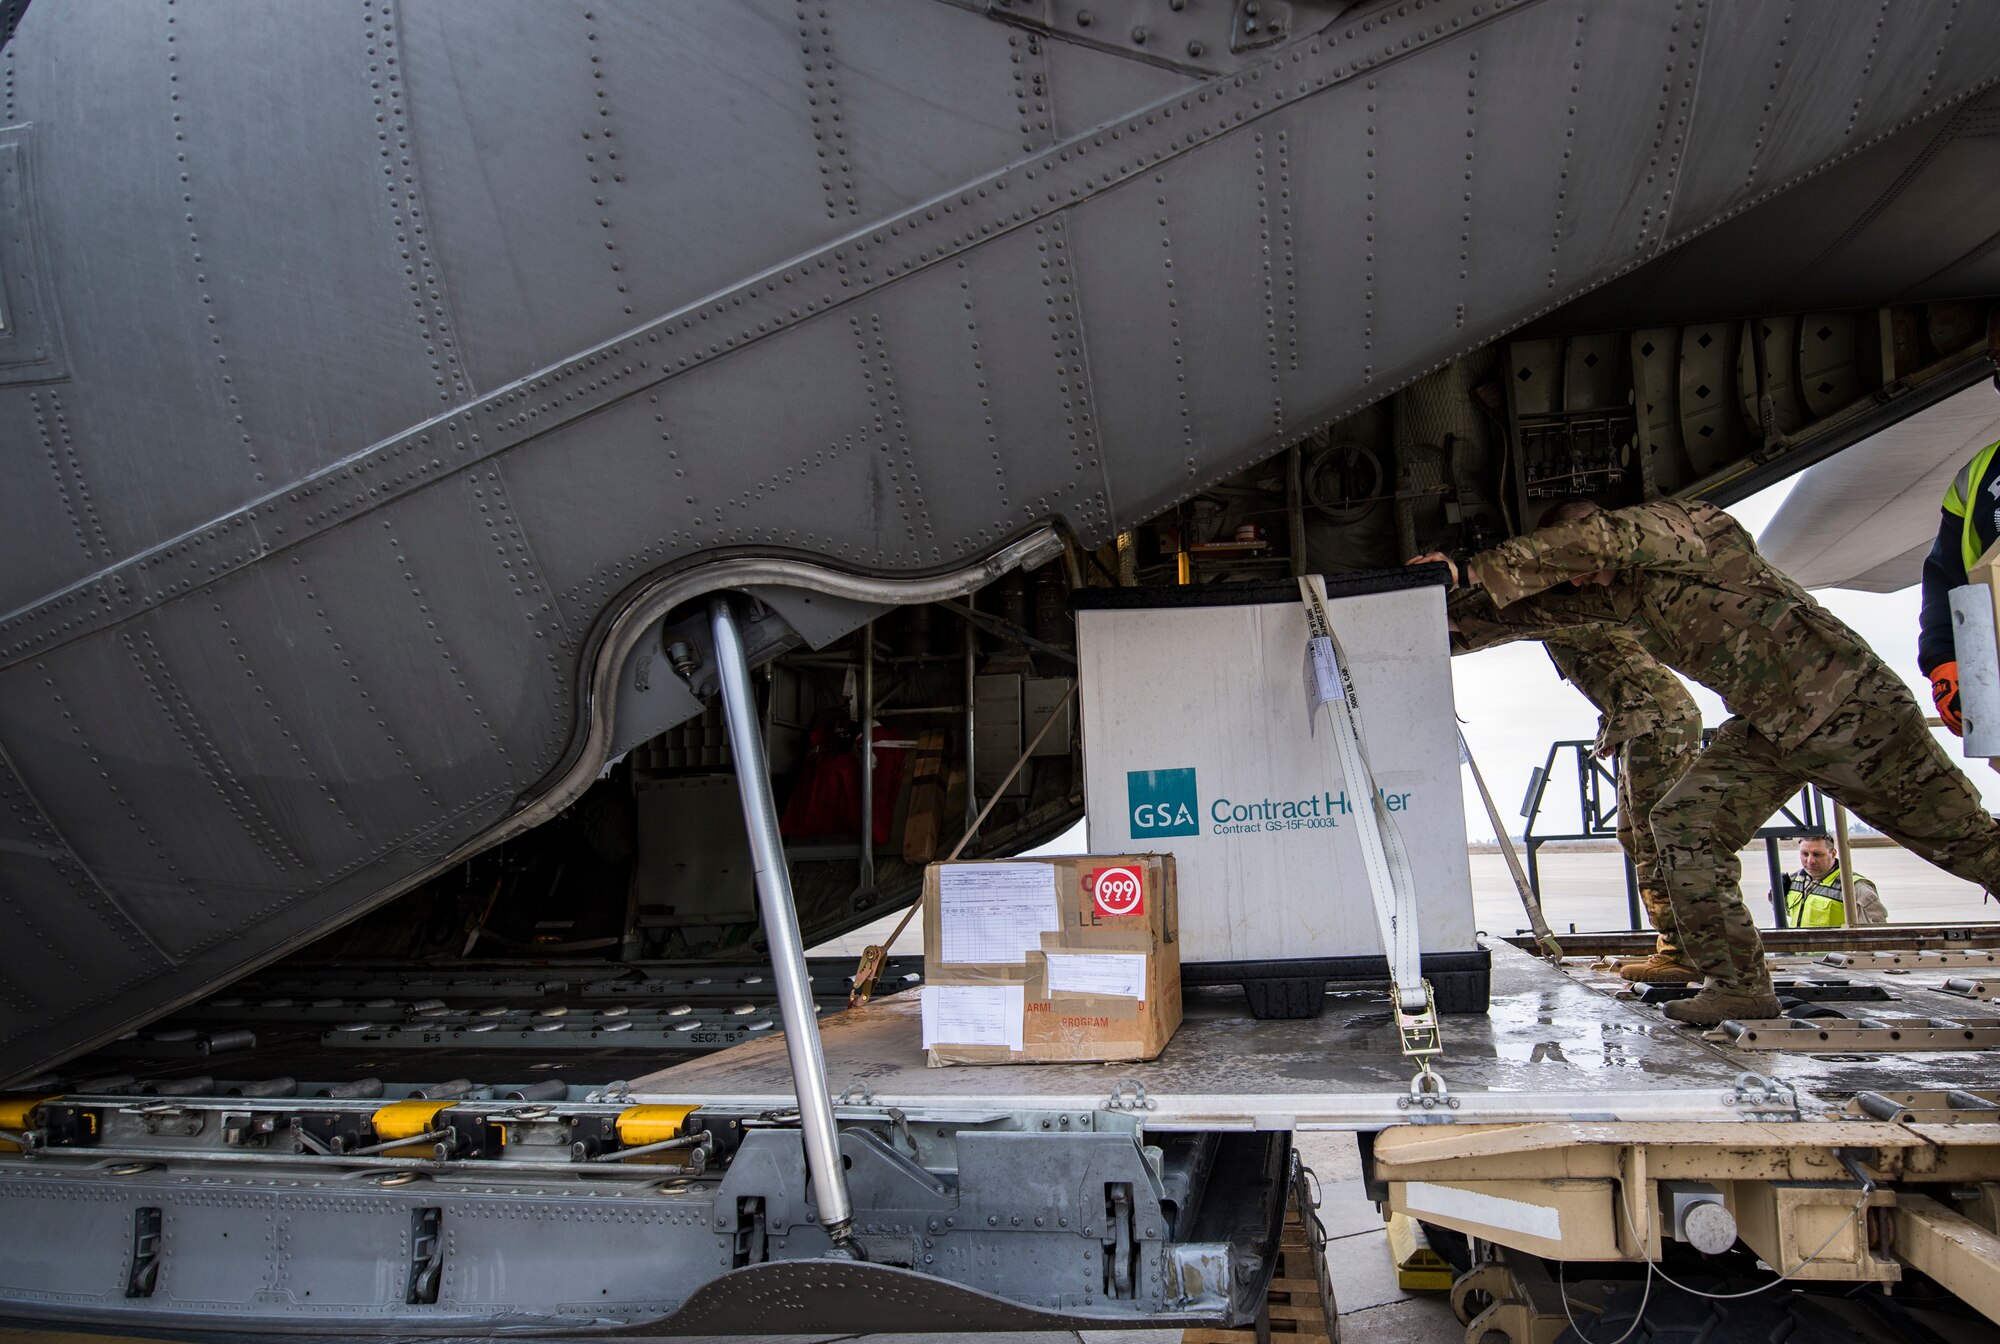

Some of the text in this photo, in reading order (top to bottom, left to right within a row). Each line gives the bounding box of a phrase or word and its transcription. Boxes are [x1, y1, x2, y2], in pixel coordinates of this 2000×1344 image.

[1348, 691, 1358, 709] 5000
[1134, 801, 1195, 828] GSA
[1211, 795, 1320, 823] Contract
[1213, 817, 1339, 835] Contract GS-15F-0003L
[1062, 1017, 1109, 1028] PROGRAM
[423, 1034, 441, 1042] B-5
[691, 1032, 735, 1043] SECT. 15
